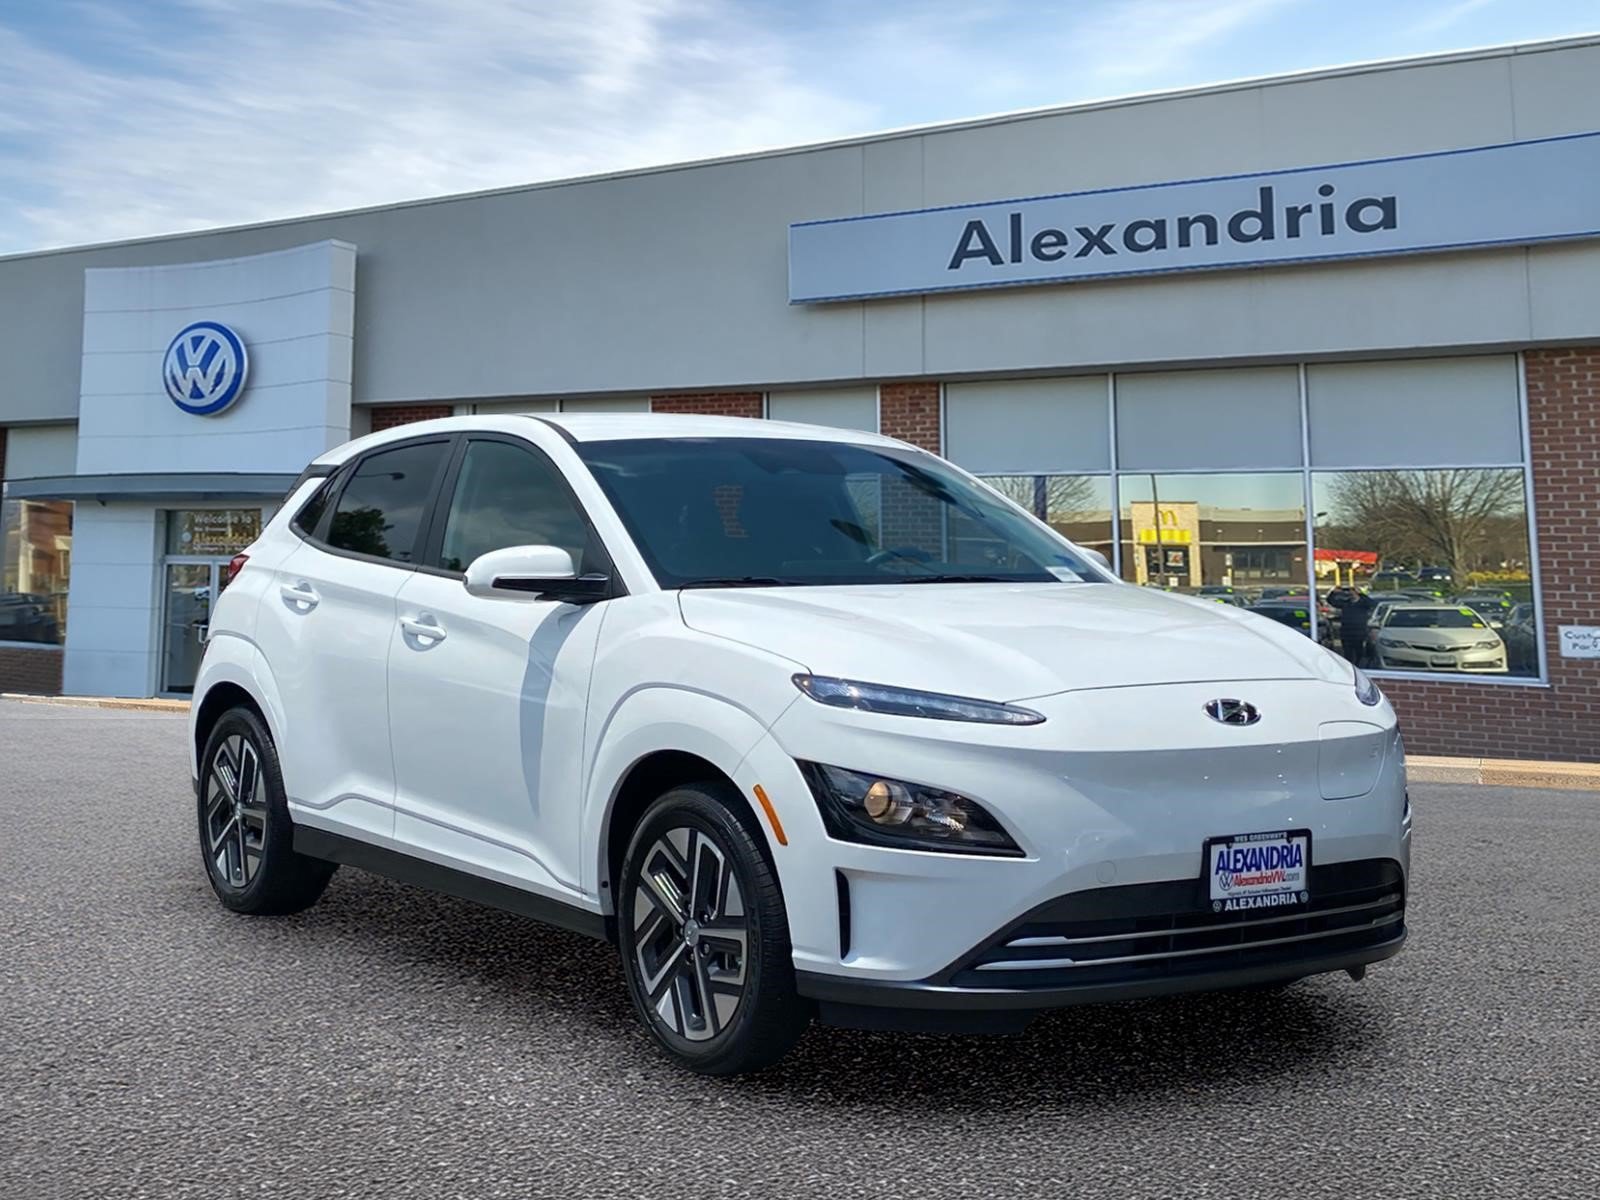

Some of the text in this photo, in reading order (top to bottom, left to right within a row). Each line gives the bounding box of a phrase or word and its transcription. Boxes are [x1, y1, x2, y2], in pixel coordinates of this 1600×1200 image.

[947, 184, 1397, 270] Alexandria
[164, 324, 242, 410] VW
[1215, 844, 1302, 875] ALEXANDRIA
[1224, 893, 1297, 911] ALEXANDRIA
